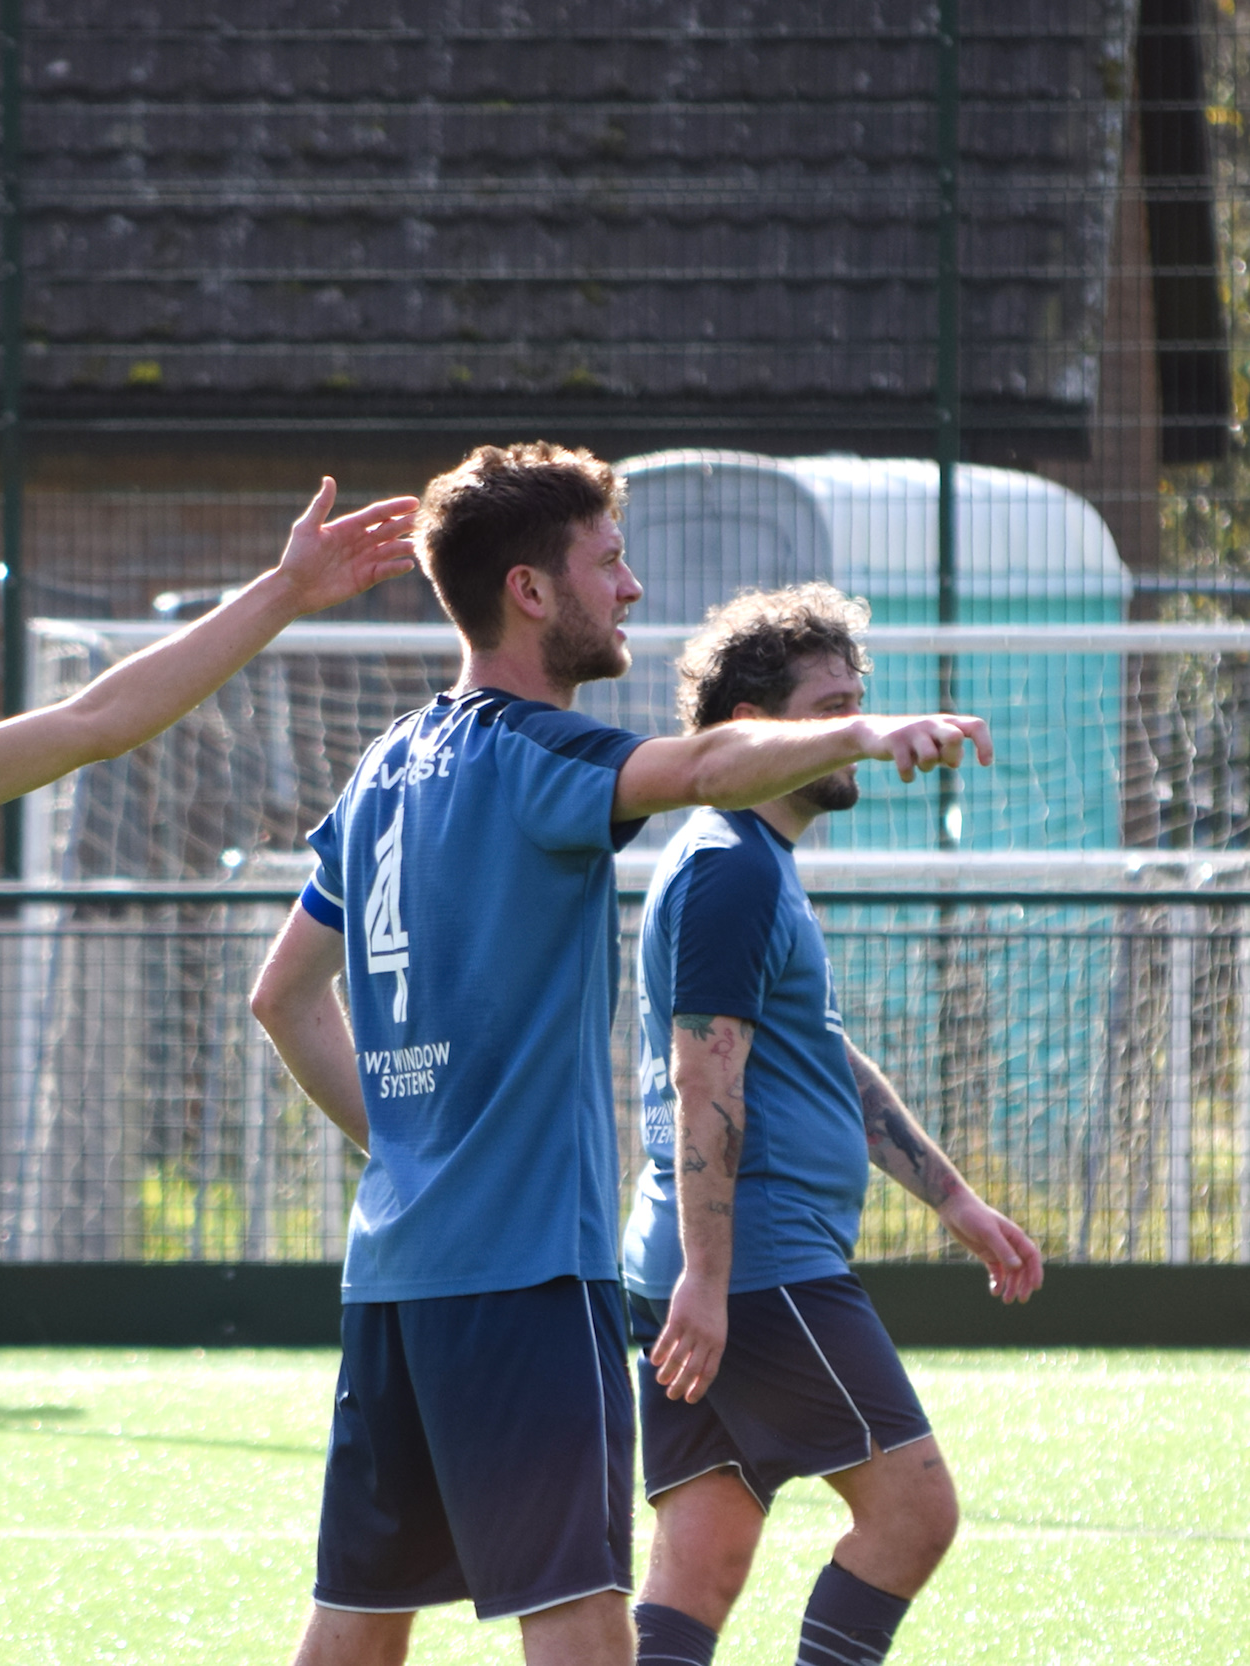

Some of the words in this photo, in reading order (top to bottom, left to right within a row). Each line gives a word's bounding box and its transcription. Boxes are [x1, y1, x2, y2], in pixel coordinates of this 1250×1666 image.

[364, 805, 410, 1024] 4
[364, 1050, 392, 1075] W2
[391, 1041, 451, 1073] WINDOW
[380, 1068, 437, 1099] SYSTEMS
